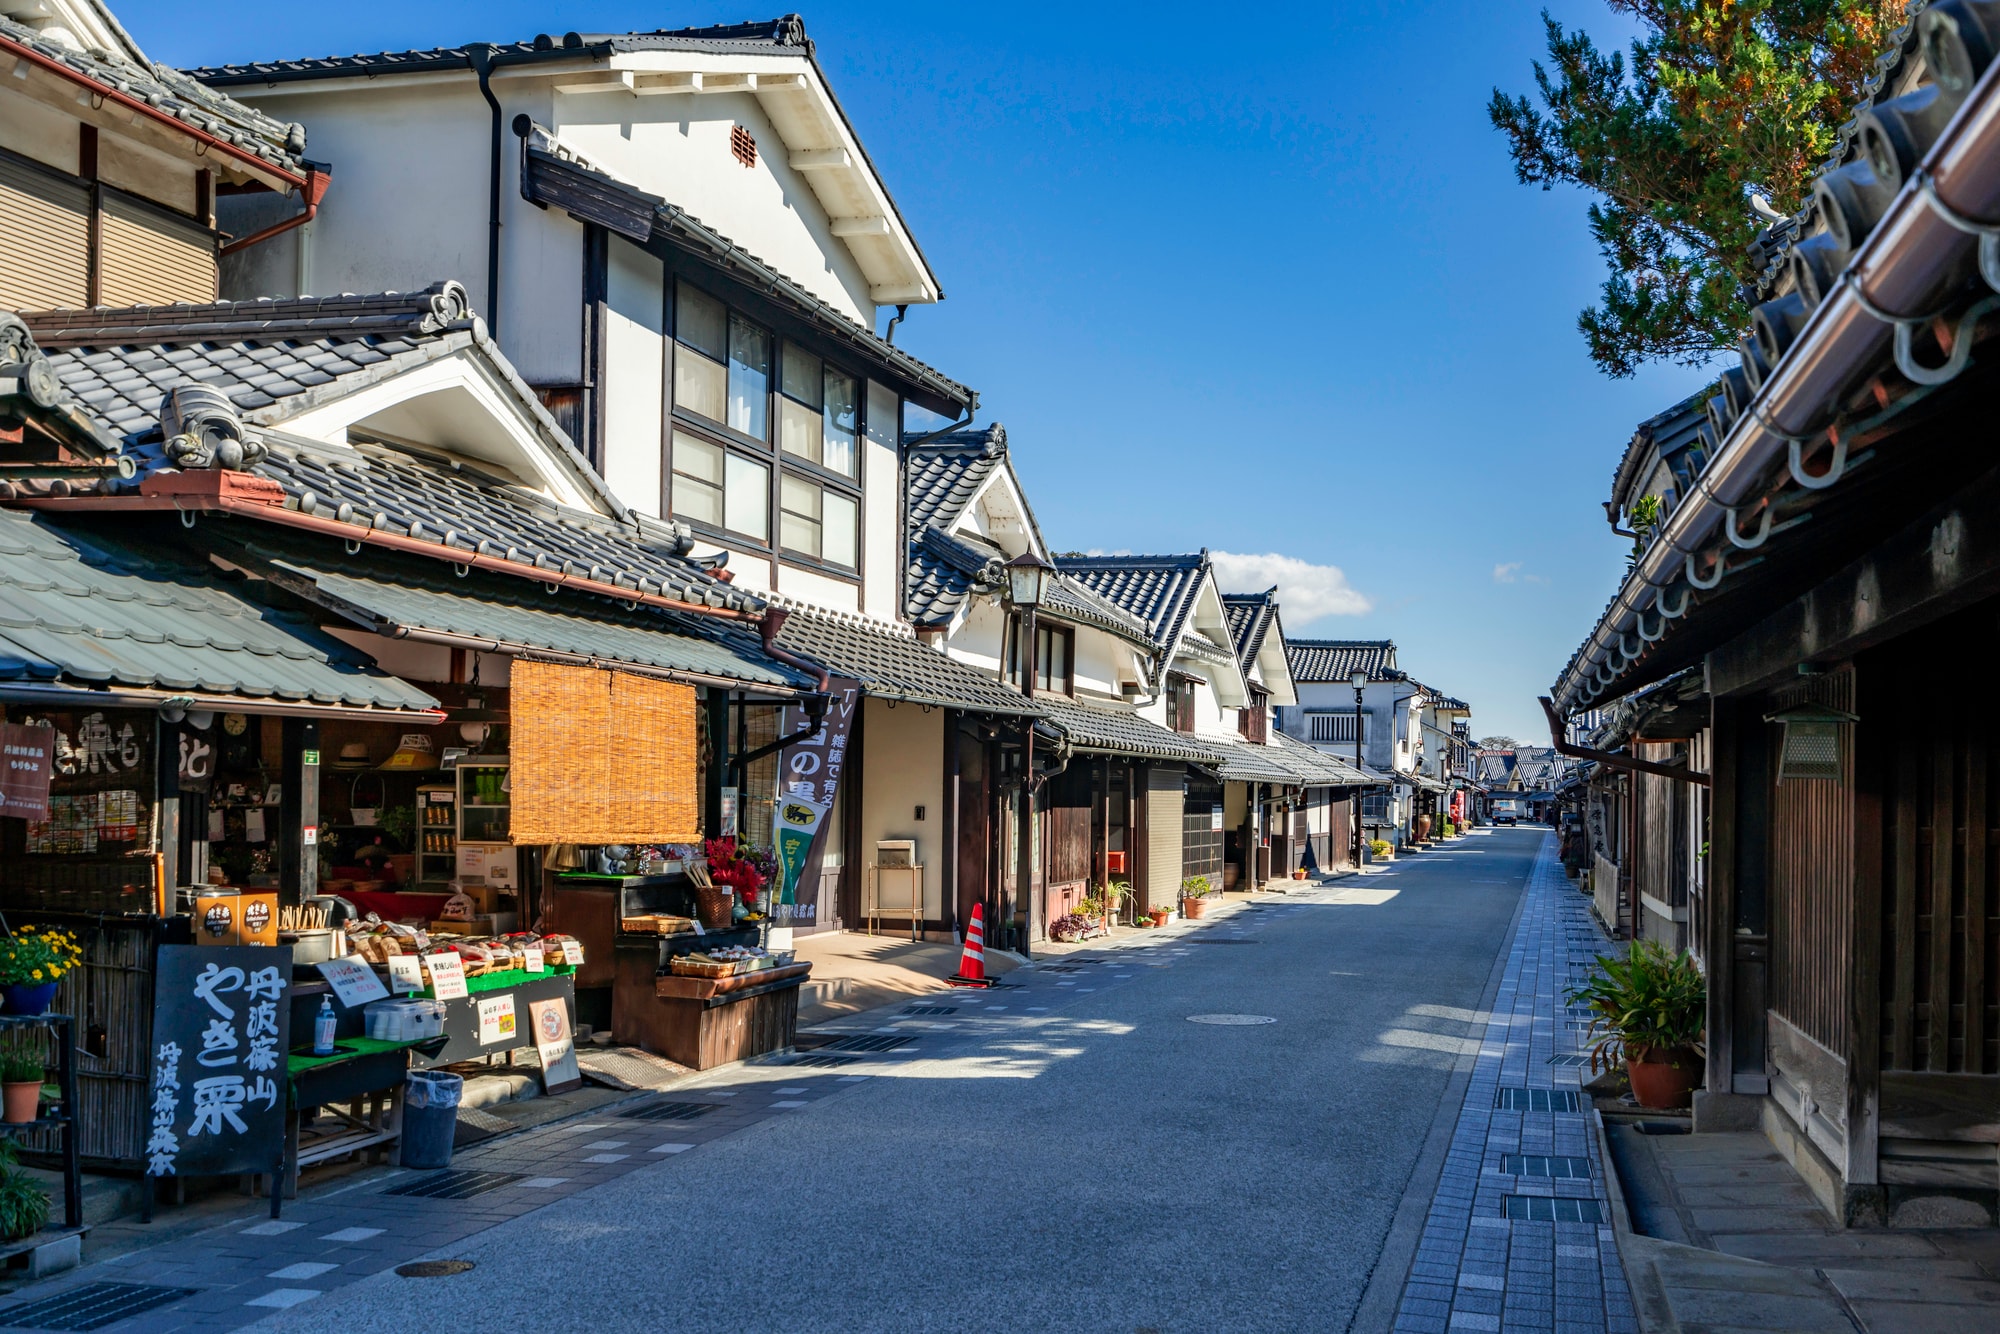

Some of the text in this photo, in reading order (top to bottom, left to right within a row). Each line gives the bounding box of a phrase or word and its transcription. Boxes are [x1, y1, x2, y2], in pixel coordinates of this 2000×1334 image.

[821, 688, 856, 809] TV・雑誌で有名
[145, 1040, 183, 1176] 丹波篠山森本
[187, 962, 249, 1137] やき栗
[243, 965, 287, 1113] 丹波篠山
